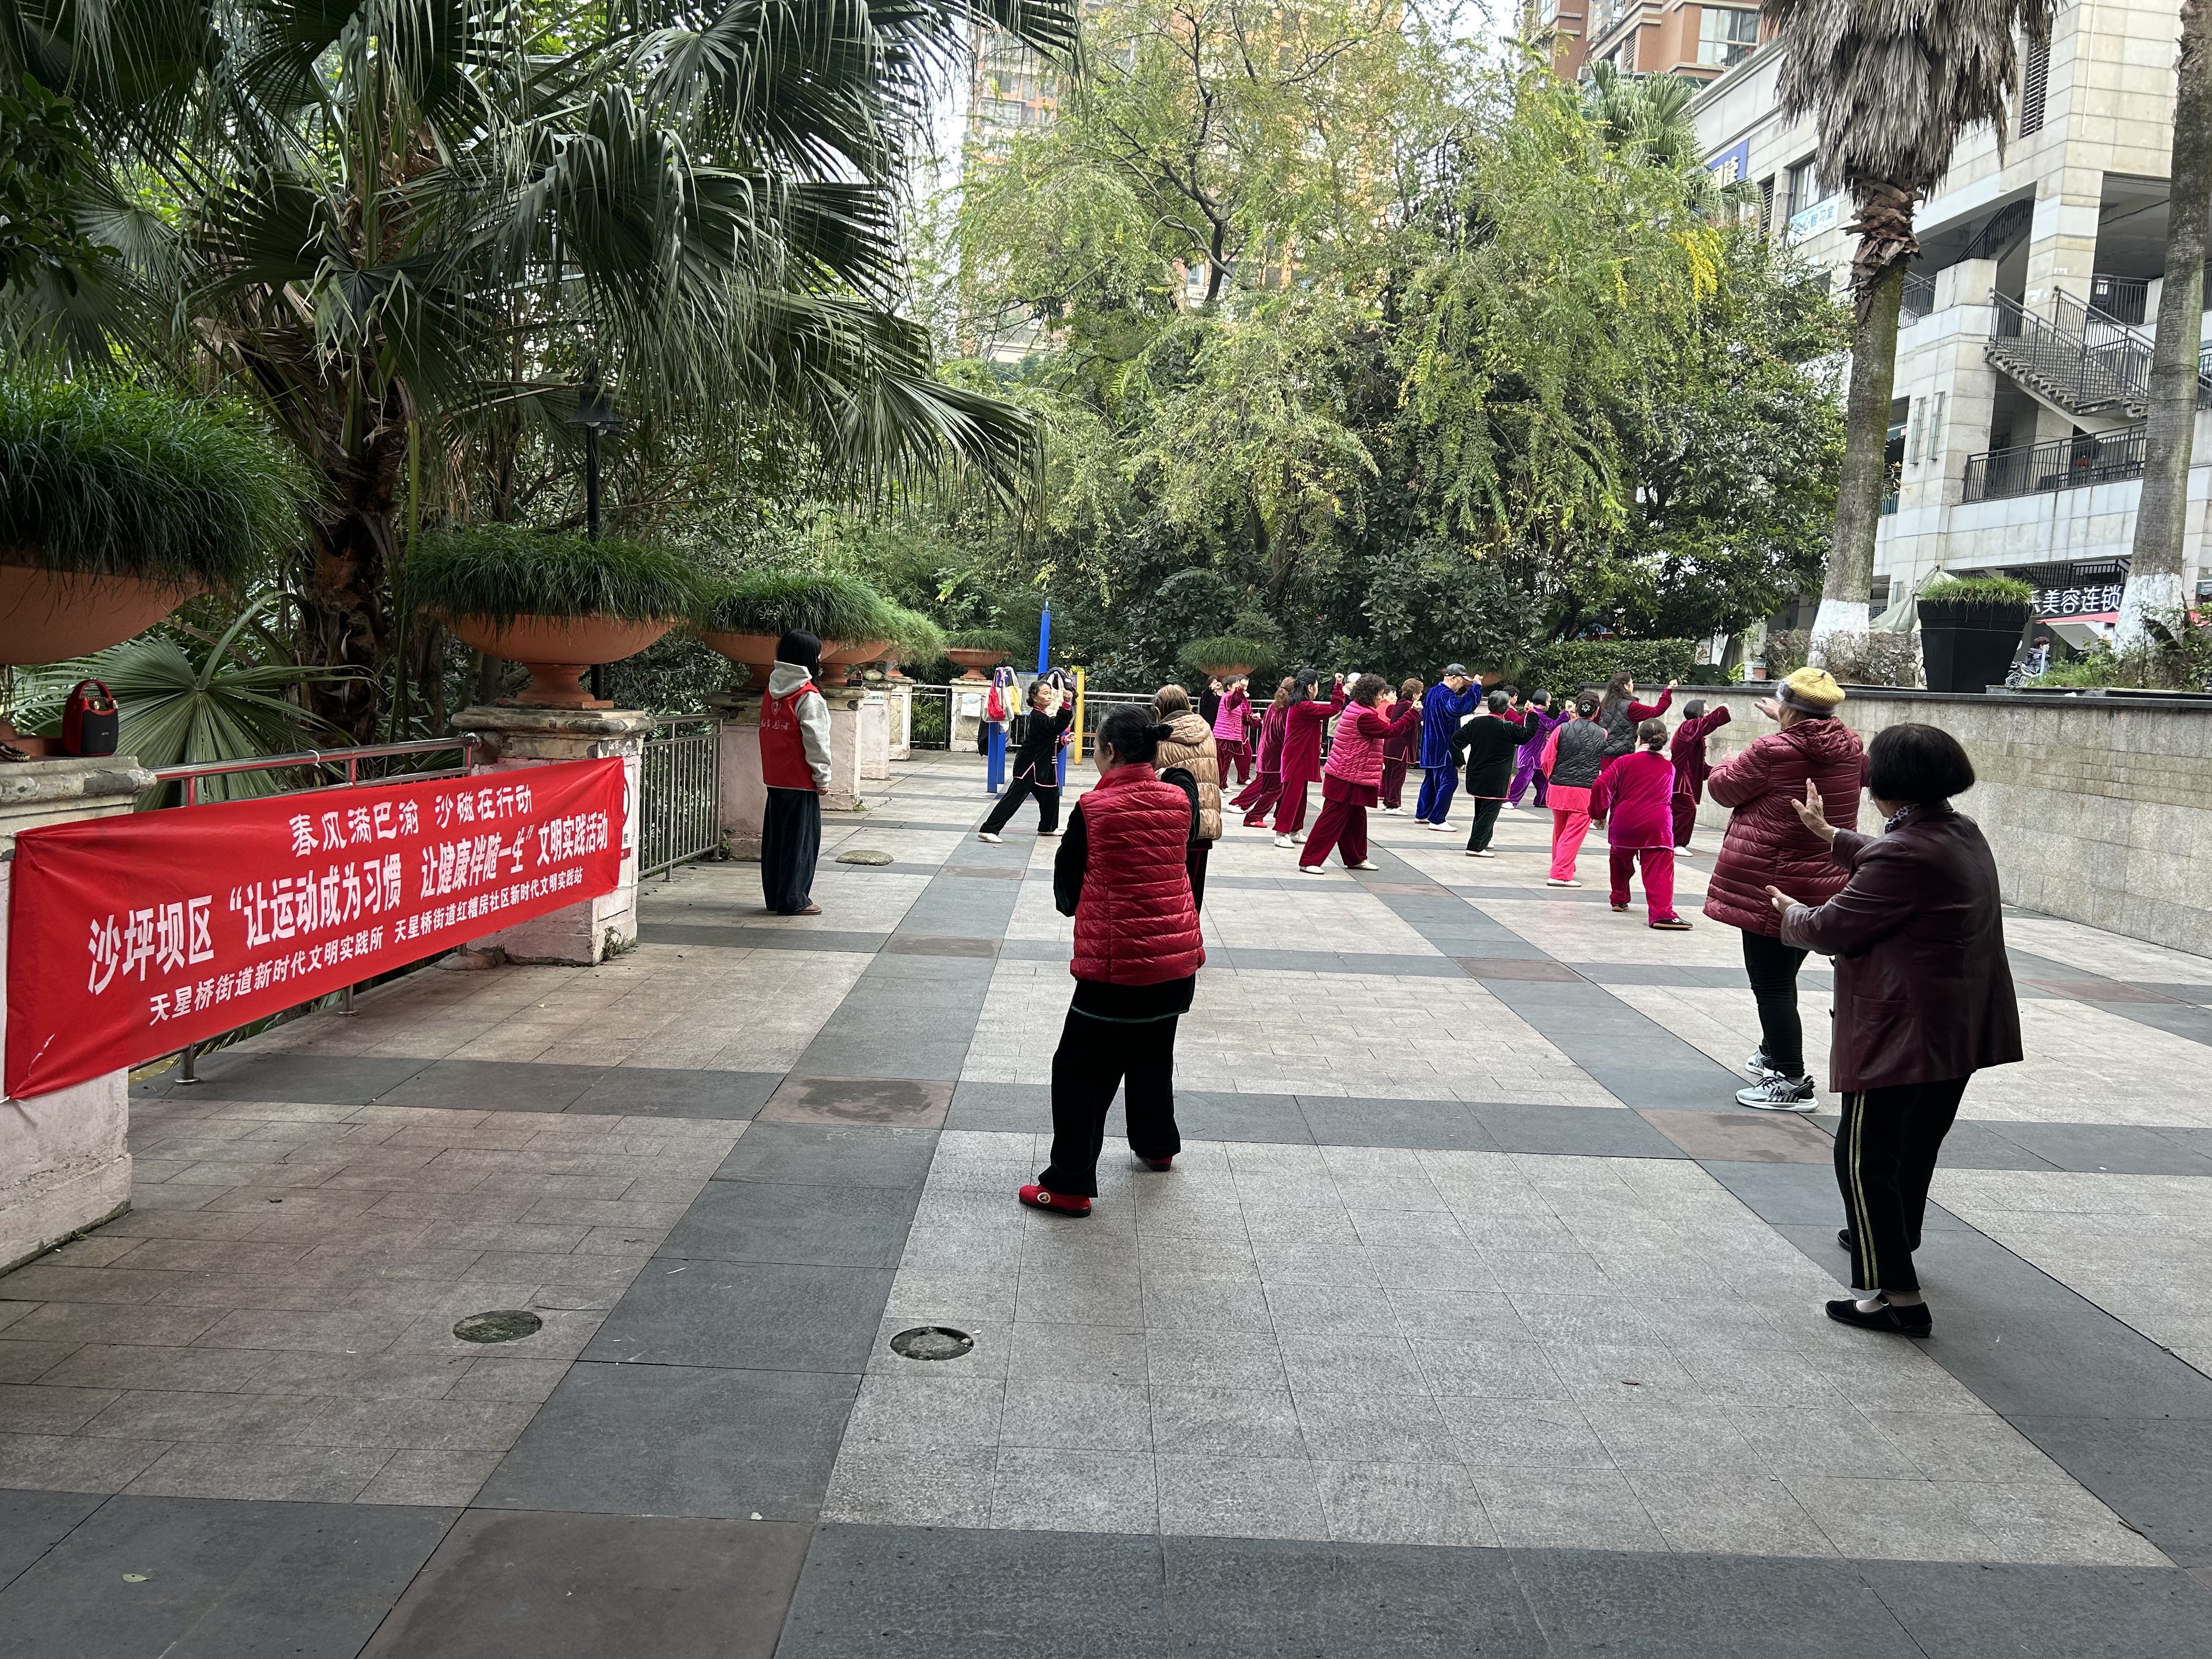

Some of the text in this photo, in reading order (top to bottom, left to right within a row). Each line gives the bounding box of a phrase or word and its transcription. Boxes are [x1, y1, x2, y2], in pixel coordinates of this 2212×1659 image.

[289, 785, 532, 857] 春风满巴渝 沙磁在行动
[88, 895, 215, 995] 沙坪坝区
[537, 808, 608, 867] 文明实践活动
[150, 925, 383, 1025] 天星桥街道新时代文明实践所
